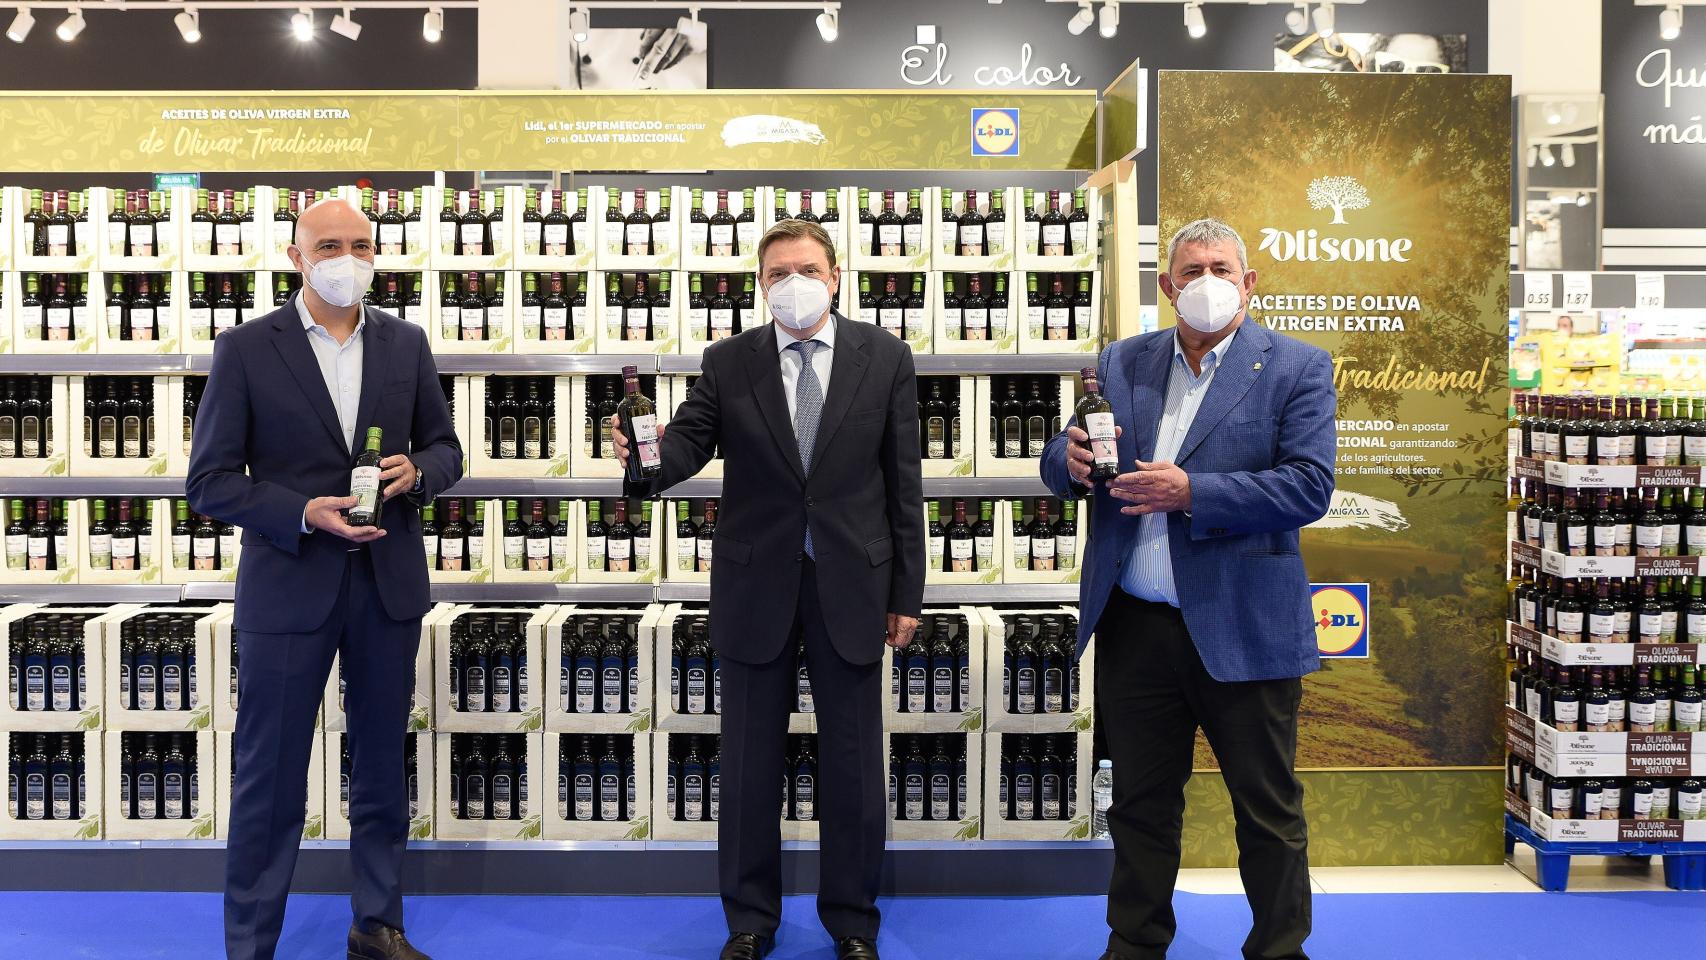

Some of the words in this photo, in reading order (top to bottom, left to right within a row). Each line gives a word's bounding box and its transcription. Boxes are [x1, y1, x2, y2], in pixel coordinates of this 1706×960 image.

[900, 43, 952, 86] El
[974, 43, 1081, 86] color
[1636, 49, 1706, 108] Qu
[162, 109, 208, 120] ACEITES
[211, 109, 225, 120] DE
[229, 109, 264, 120] OLIVA
[267, 109, 311, 120] VIRGEN
[313, 108, 351, 120] EXTRA
[575, 120, 662, 131] SUPERMERCADO
[676, 122, 706, 132] apostar
[139, 127, 165, 155] de
[174, 127, 244, 157] Olivar
[246, 126, 374, 160] Tradicional
[545, 136, 559, 144] por
[570, 134, 610, 144] OLIVAR
[612, 134, 686, 144] TRADICIONAL
[1258, 228, 1413, 263] Olisone
[1249, 295, 1327, 311] ACEITES
[1332, 295, 1356, 311] DE
[1360, 295, 1421, 311] OLIVA
[1527, 293, 1549, 304] 0.55
[1566, 293, 1589, 305] 1.87
[1265, 316, 1339, 332] VIRGEN
[1344, 316, 1405, 332] EXTRA
[1332, 354, 1490, 394] Tradicional
[1396, 424, 1409, 432] en
[1411, 423, 1450, 432] apostar
[1389, 438, 1458, 450] garantizando:
[1340, 454, 1352, 462] de
[1354, 454, 1368, 462] los
[1370, 454, 1426, 464] agricultores.
[1344, 466, 1357, 475] de
[1359, 466, 1394, 475] familias
[1395, 466, 1410, 475] del
[1412, 466, 1442, 475] sector.
[1654, 469, 1682, 477] OLIVAR
[1639, 478, 1696, 486] TRADICIONAL
[1328, 508, 1370, 516] MIGASA
[1653, 560, 1680, 568] OLIVAR
[1638, 568, 1694, 576] TRADICIONAL
[1315, 608, 1360, 630] IDL
[1652, 646, 1680, 655] OLIVAR
[1637, 655, 1693, 663] TRADICIONAL
[1645, 736, 1673, 744] OLIVAR
[1630, 744, 1687, 752] TRADICIONAL
[1630, 758, 1687, 766] TRADICIONAL
[1636, 822, 1665, 830] OLIVAR
[1622, 830, 1679, 838] TRADICIONAL
